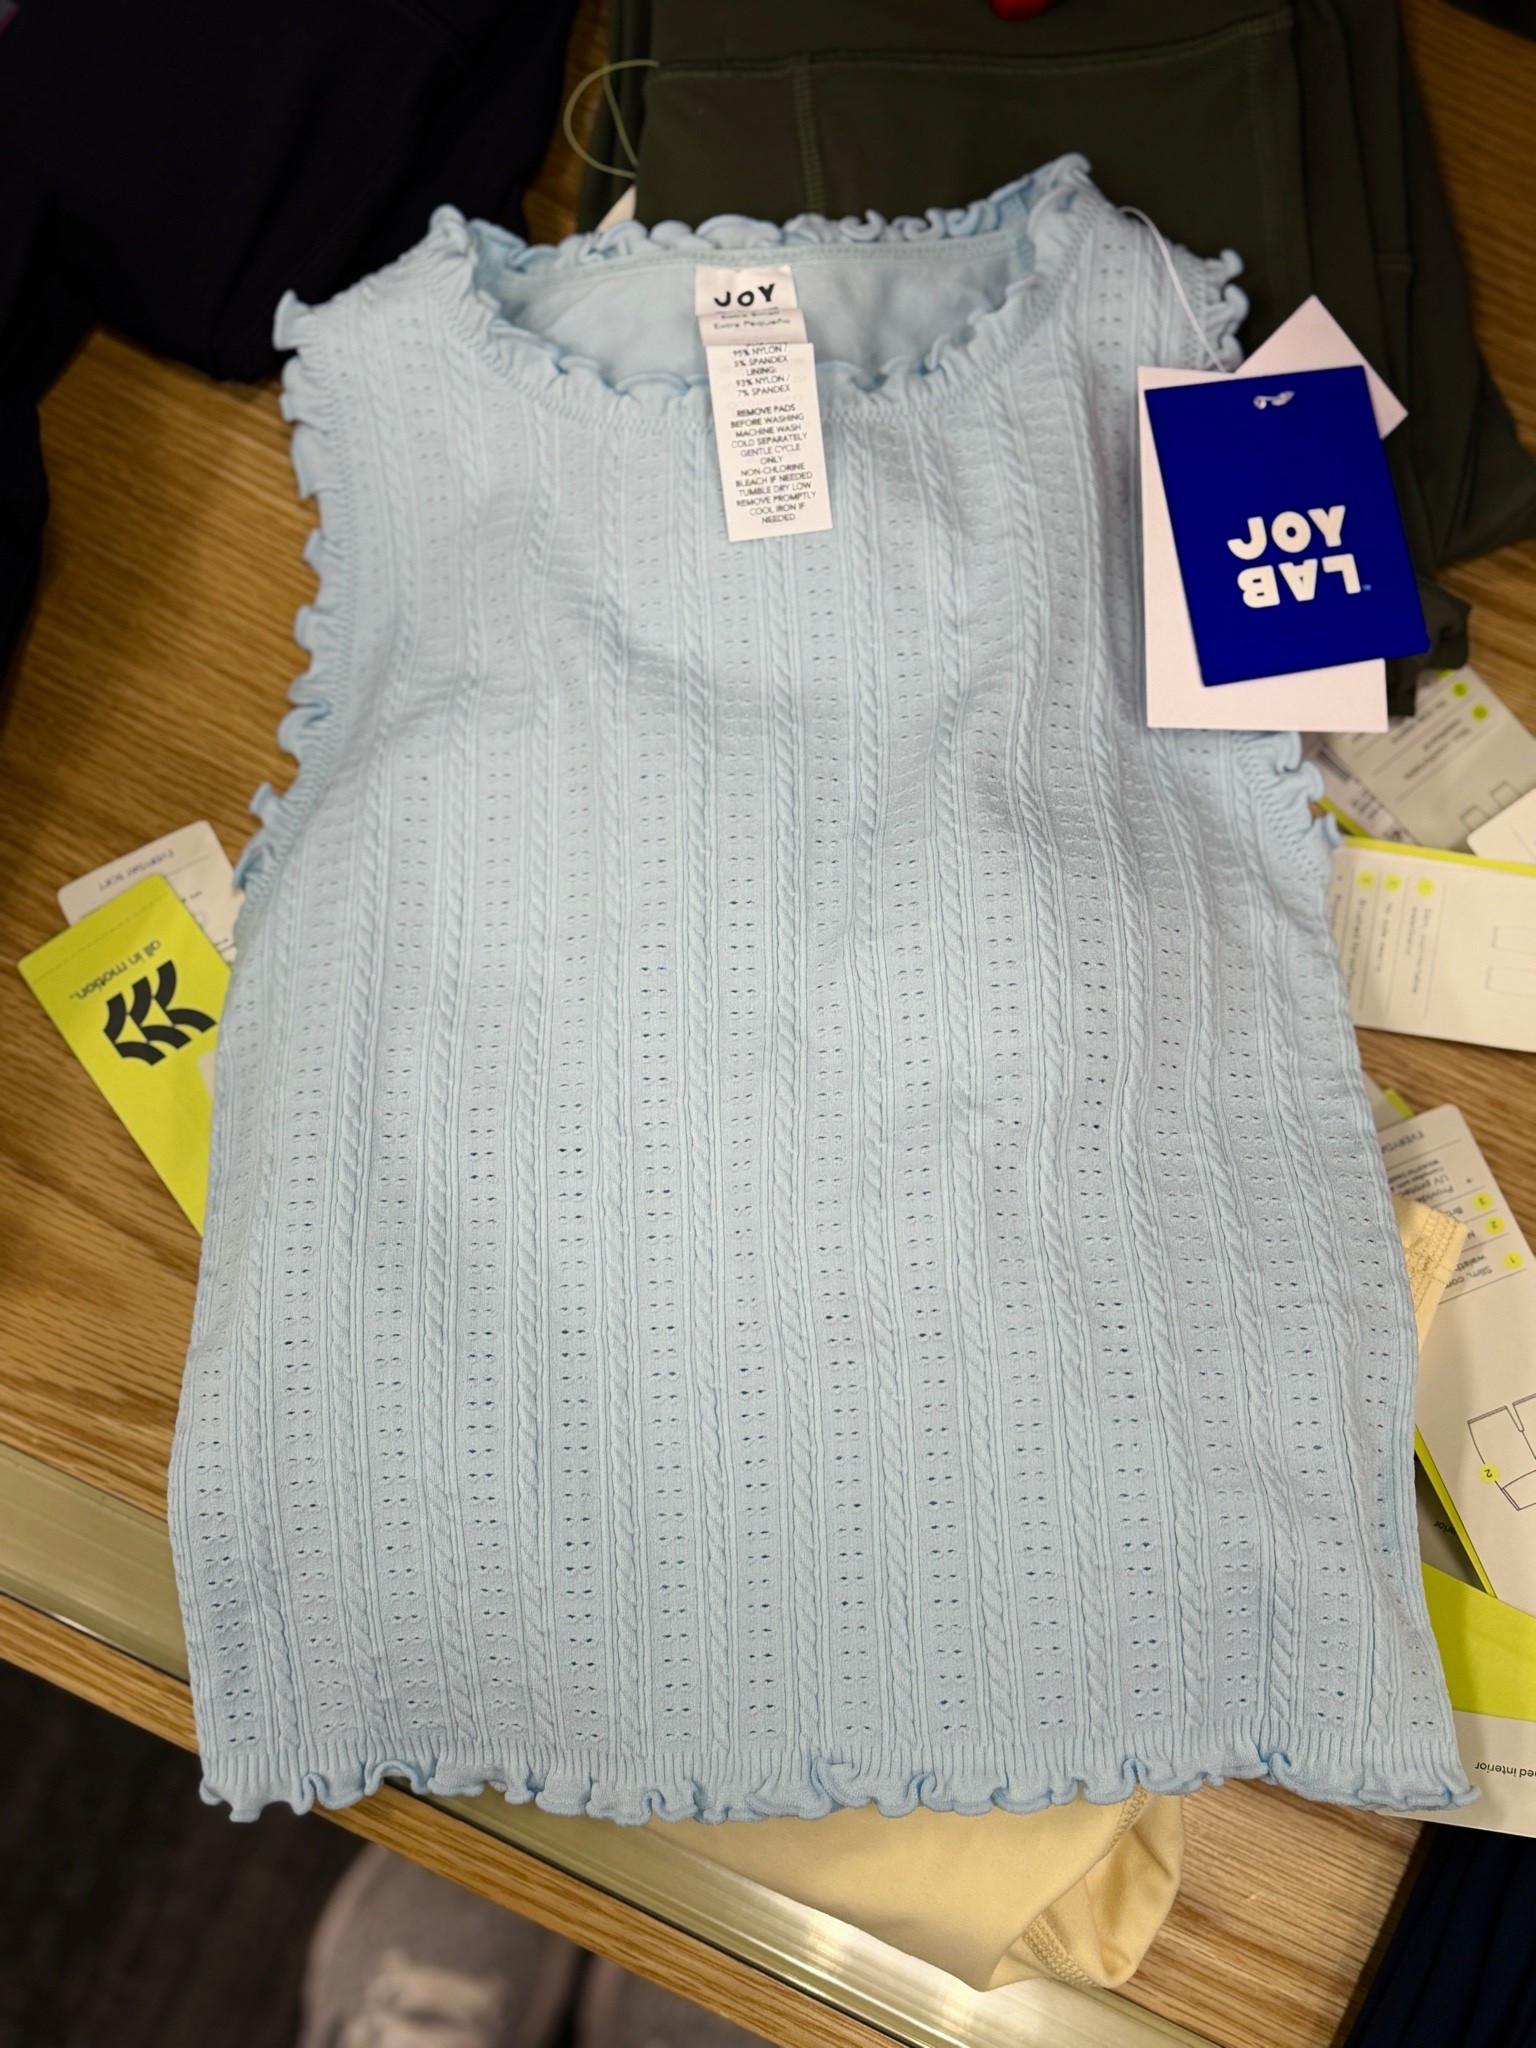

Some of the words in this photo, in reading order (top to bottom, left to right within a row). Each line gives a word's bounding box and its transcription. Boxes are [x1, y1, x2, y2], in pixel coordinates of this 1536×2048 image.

[713, 283, 776, 307] JOY
[752, 344, 782, 355] NYLON
[749, 354, 789, 366] SPANDEX
[755, 375, 785, 385] NYLON
[751, 383, 791, 396] SPANDEX
[736, 406, 772, 417] REMOVE
[773, 403, 796, 413] PADS
[730, 417, 763, 428] BEFORE
[764, 413, 805, 424] WASHING
[735, 426, 774, 438] MACHINE
[776, 423, 801, 433] WASH
[731, 438, 755, 448] COLD
[757, 432, 808, 446] SEPARATELY
[740, 446, 773, 457] GENTLE
[774, 443, 801, 453] CYCLE
[760, 456, 783, 465] ONLY
[741, 462, 805, 477] NON-CHLORINE
[735, 477, 768, 487] BLEACH
[770, 474, 776, 483] IF
[779, 471, 813, 482] NEEDED
[738, 486, 771, 497] TUMBLE
[773, 484, 790, 493] DRY
[792, 481, 812, 491] LOW
[736, 495, 771, 507] REMOVE
[773, 491, 816, 503] PROMPTLY
[749, 506, 775, 516] COOL
[776, 503, 797, 513] IRON
[798, 502, 805, 510] IF
[762, 513, 796, 524] NEEDED
[1227, 505, 1346, 560] JOY
[1237, 553, 1362, 609] LAB
[143, 939, 162, 957] all
[128, 952, 145, 965] in
[1484, 1468, 1493, 1479] 2
[1474, 1762, 1517, 1778] interior
[1519, 1768, 1536, 1778] ed
